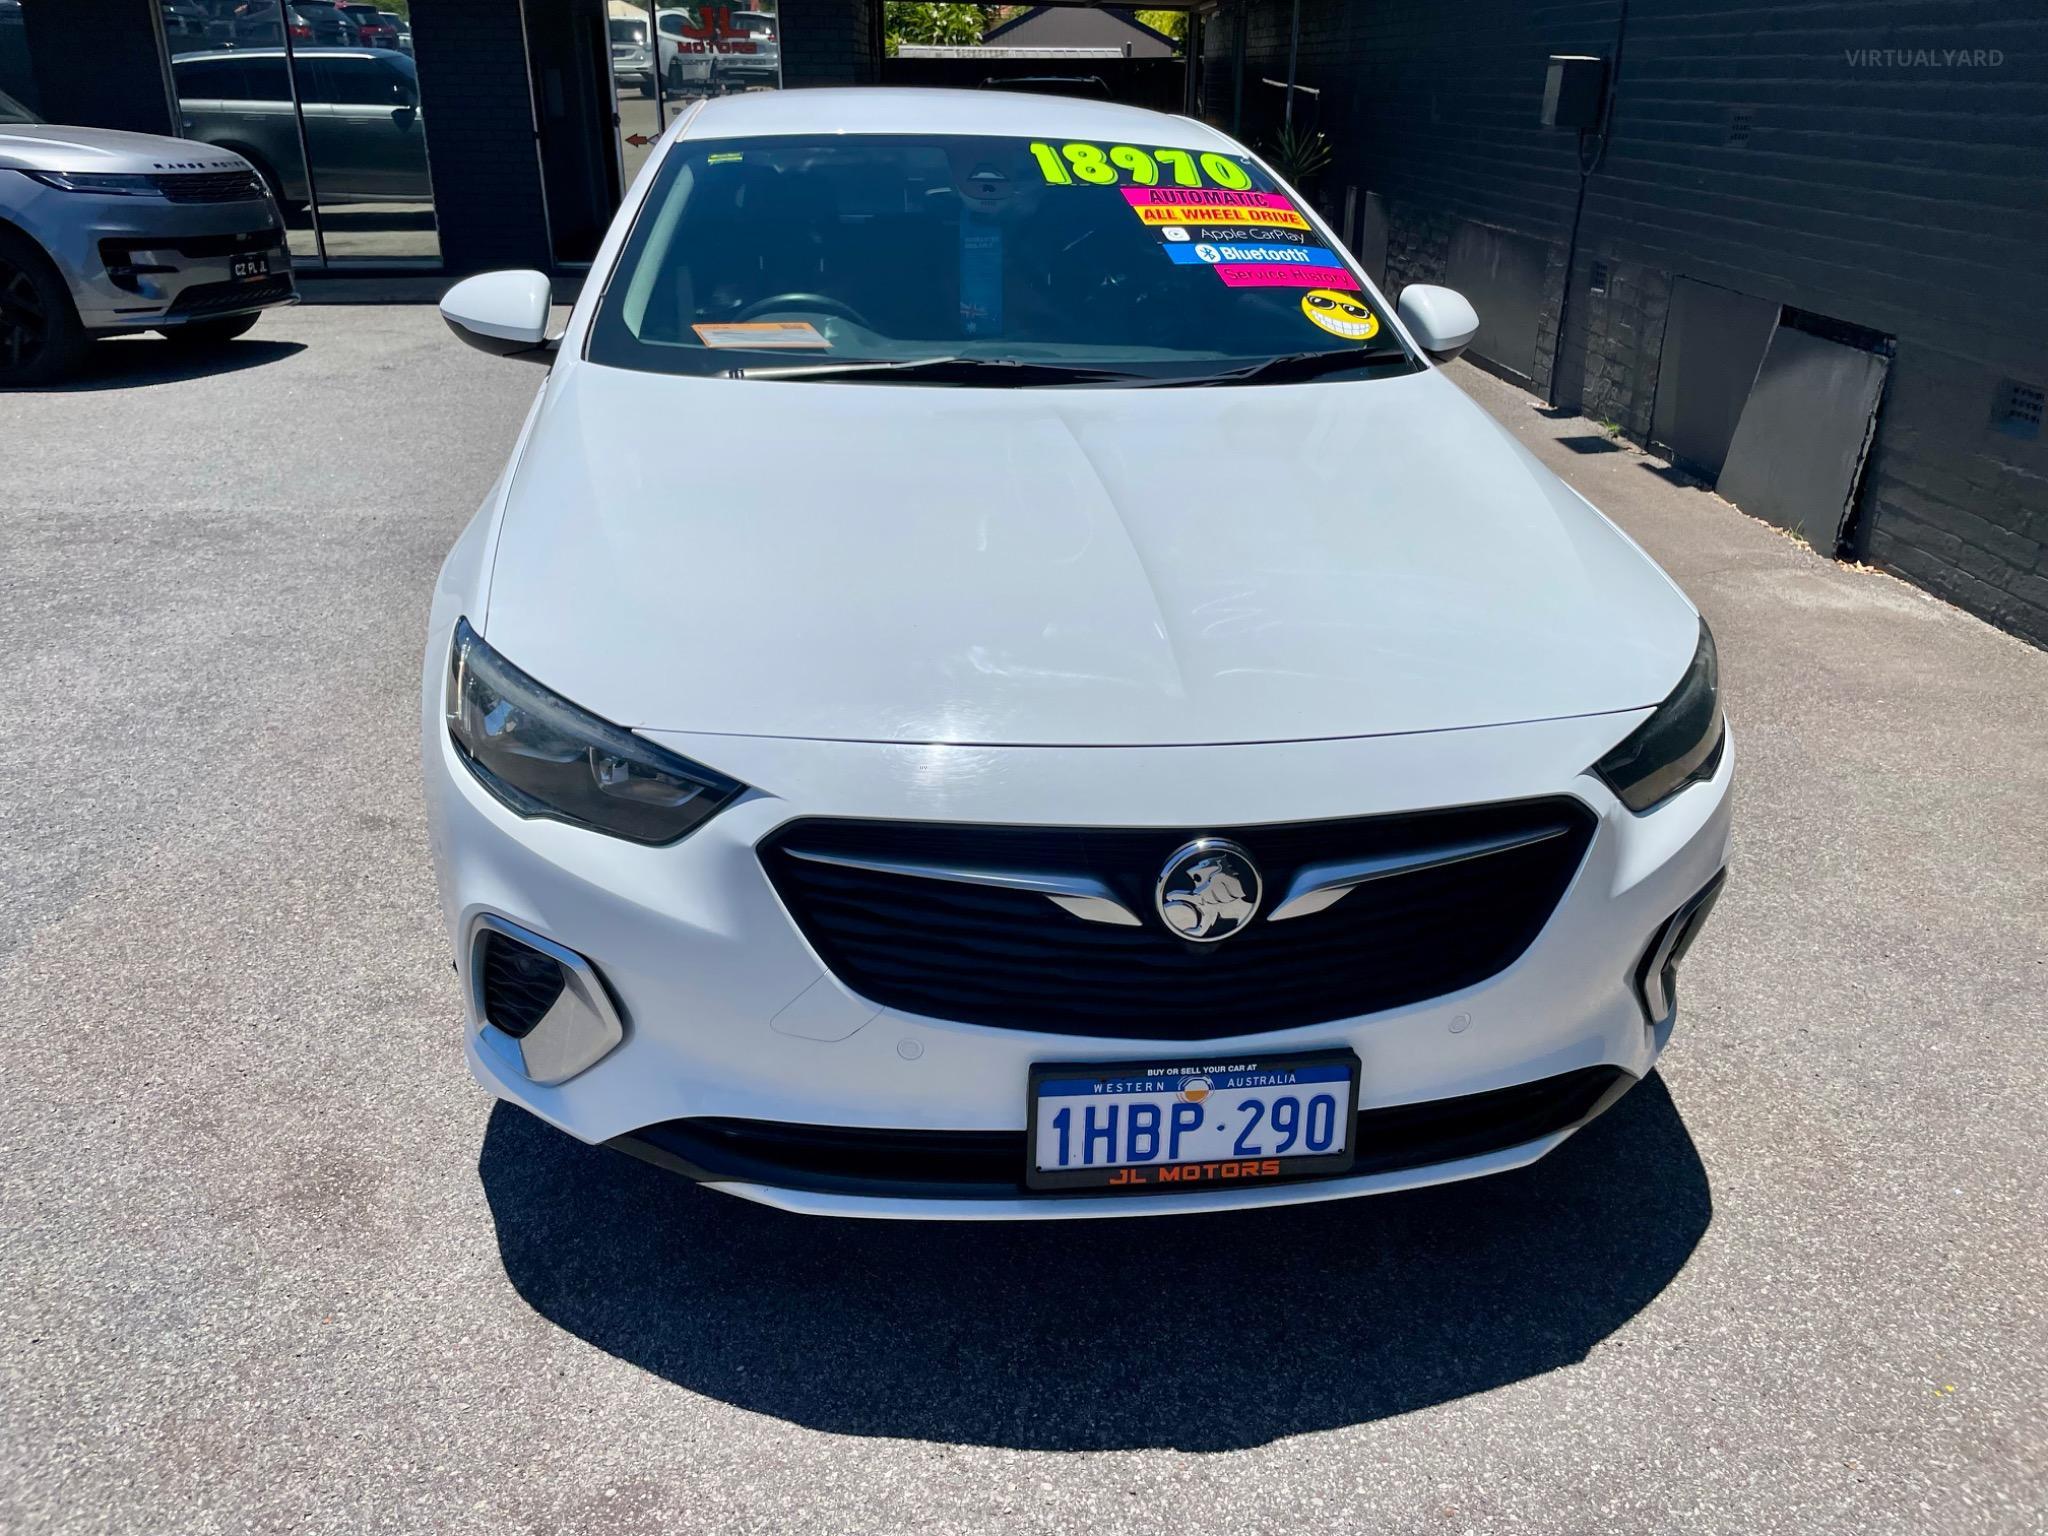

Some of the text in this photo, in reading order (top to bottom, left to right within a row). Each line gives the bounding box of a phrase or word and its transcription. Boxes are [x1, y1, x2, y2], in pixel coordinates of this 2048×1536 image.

[680, 5, 751, 38] JL
[677, 40, 758, 54] MOTORS
[1029, 143, 1252, 191] 18970
[1150, 189, 1269, 207] AUTOMATIC
[1144, 208, 1301, 225] ALL WHEEL DRIVE
[1201, 228, 1305, 244] Apple CarPlay
[1219, 246, 1311, 263] Bluetooth
[1224, 268, 1349, 287] Service History
[1147, 1064, 1257, 1077] BUY OR SELL YOUR CAR AT
[1093, 1074, 1297, 1094] WESTERN AUSTRALIA
[1109, 1160, 1281, 1185] JL MOTORS
